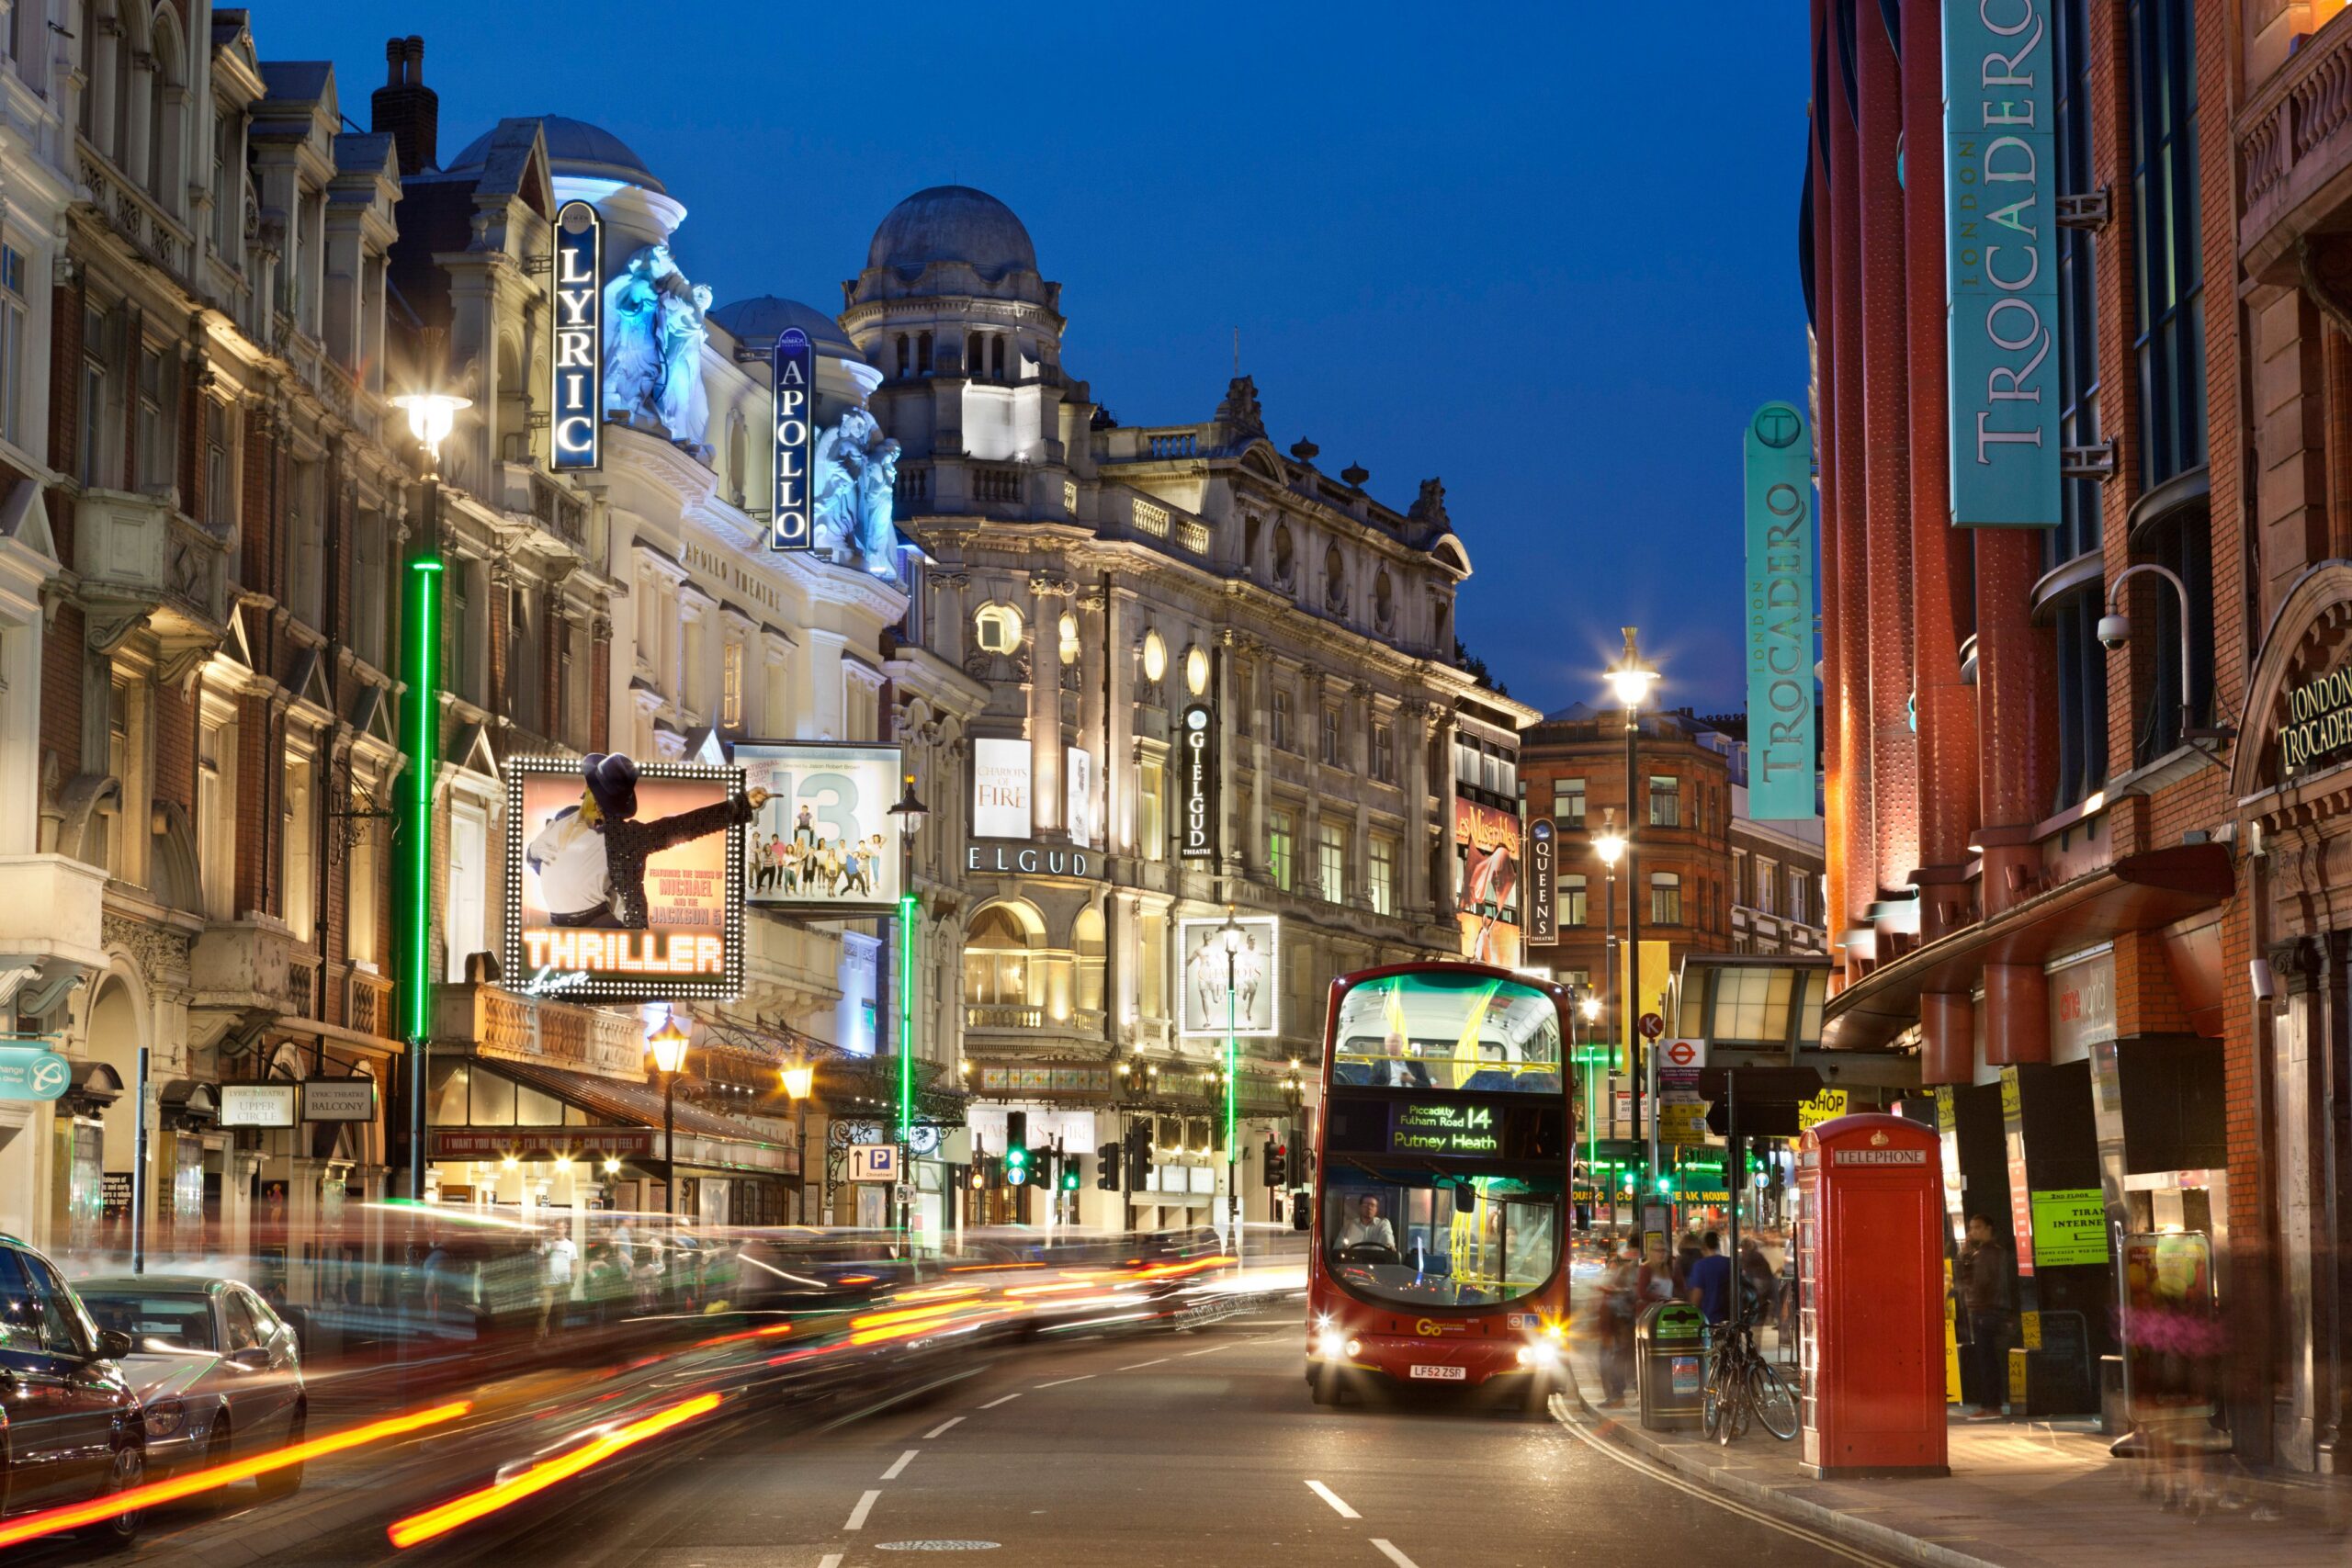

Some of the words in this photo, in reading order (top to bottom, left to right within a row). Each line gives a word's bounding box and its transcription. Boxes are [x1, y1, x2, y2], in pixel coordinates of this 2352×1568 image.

[1958, 141, 1978, 286] LONDON
[1976, 0, 2051, 465] TROCADERO
[557, 249, 593, 452] LYRIC
[776, 360, 808, 538] APOLLO
[685, 541, 728, 581] APOLLO
[734, 568, 781, 613] THEATRE
[1752, 581, 1765, 673] LONDON
[1763, 483, 1809, 783] TROCADERO
[2290, 666, 2352, 724] LONDON
[745, 760, 780, 773] ATIONAL
[747, 769, 771, 779] OUTH
[978, 766, 1027, 777] CHARIOTS
[978, 784, 1026, 808] FIRE
[1189, 731, 1204, 847] GIELGUD
[773, 772, 860, 847] 13
[660, 879, 713, 897] MICHAEL
[1536, 842, 1551, 934] QUEENS
[650, 906, 709, 925] JACKSON
[713, 908, 721, 926] 5
[524, 931, 721, 974] THRILLER
[1645, 1017, 1658, 1032] K
[239, 1101, 276, 1111] UPPER
[311, 1102, 364, 1111] BALCONY
[1409, 1105, 1455, 1118] Piccadilly
[237, 1112, 277, 1122] CIRCLE
[1400, 1115, 1436, 1126] Fulham
[1440, 1117, 1464, 1127] Road
[1467, 1106, 1492, 1129] 14
[451, 1138, 472, 1148] WANT
[475, 1138, 489, 1148] YOU
[492, 1138, 511, 1148] BACK
[525, 1138, 537, 1148] I'LL
[602, 1138, 616, 1148] YOU
[619, 1138, 633, 1148] FEEL
[636, 1138, 642, 1148] IT
[1395, 1132, 1446, 1152] Putney
[1452, 1134, 1497, 1149] Heath
[874, 1151, 888, 1168] P
[1839, 1150, 1922, 1163] TELEPHONE
[2053, 1218, 2106, 1228] INTERNE
[1416, 1318, 1442, 1336] Go
[1415, 1367, 1440, 1377] LF52
[1442, 1368, 1462, 1378] ZSR
